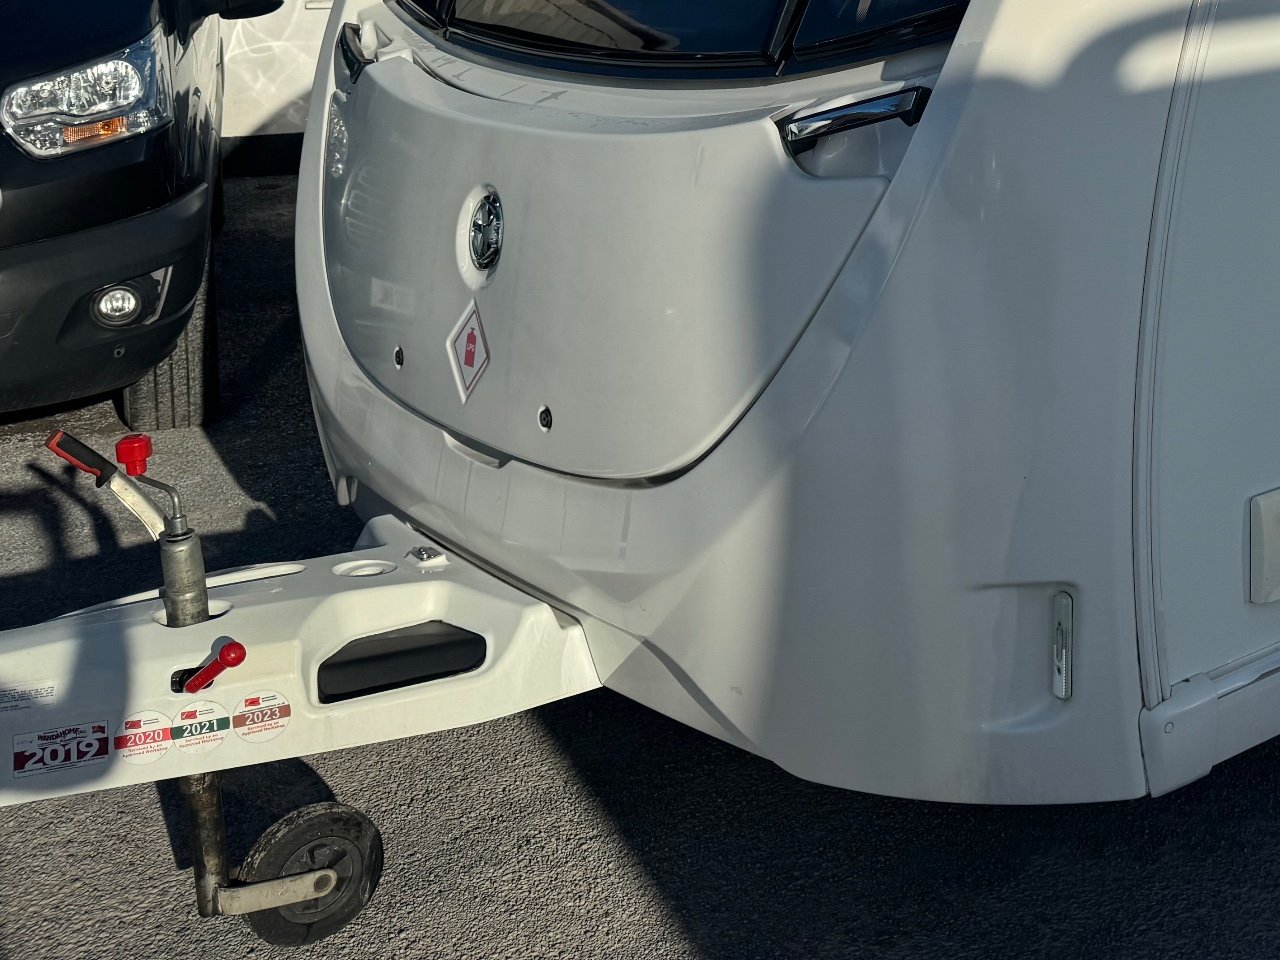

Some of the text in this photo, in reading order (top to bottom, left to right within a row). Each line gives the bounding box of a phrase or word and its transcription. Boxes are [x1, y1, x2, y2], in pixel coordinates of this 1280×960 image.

[245, 707, 281, 726] 2023
[126, 729, 163, 747] 2020
[182, 719, 218, 738] 2021
[23, 739, 100, 771] 2019
